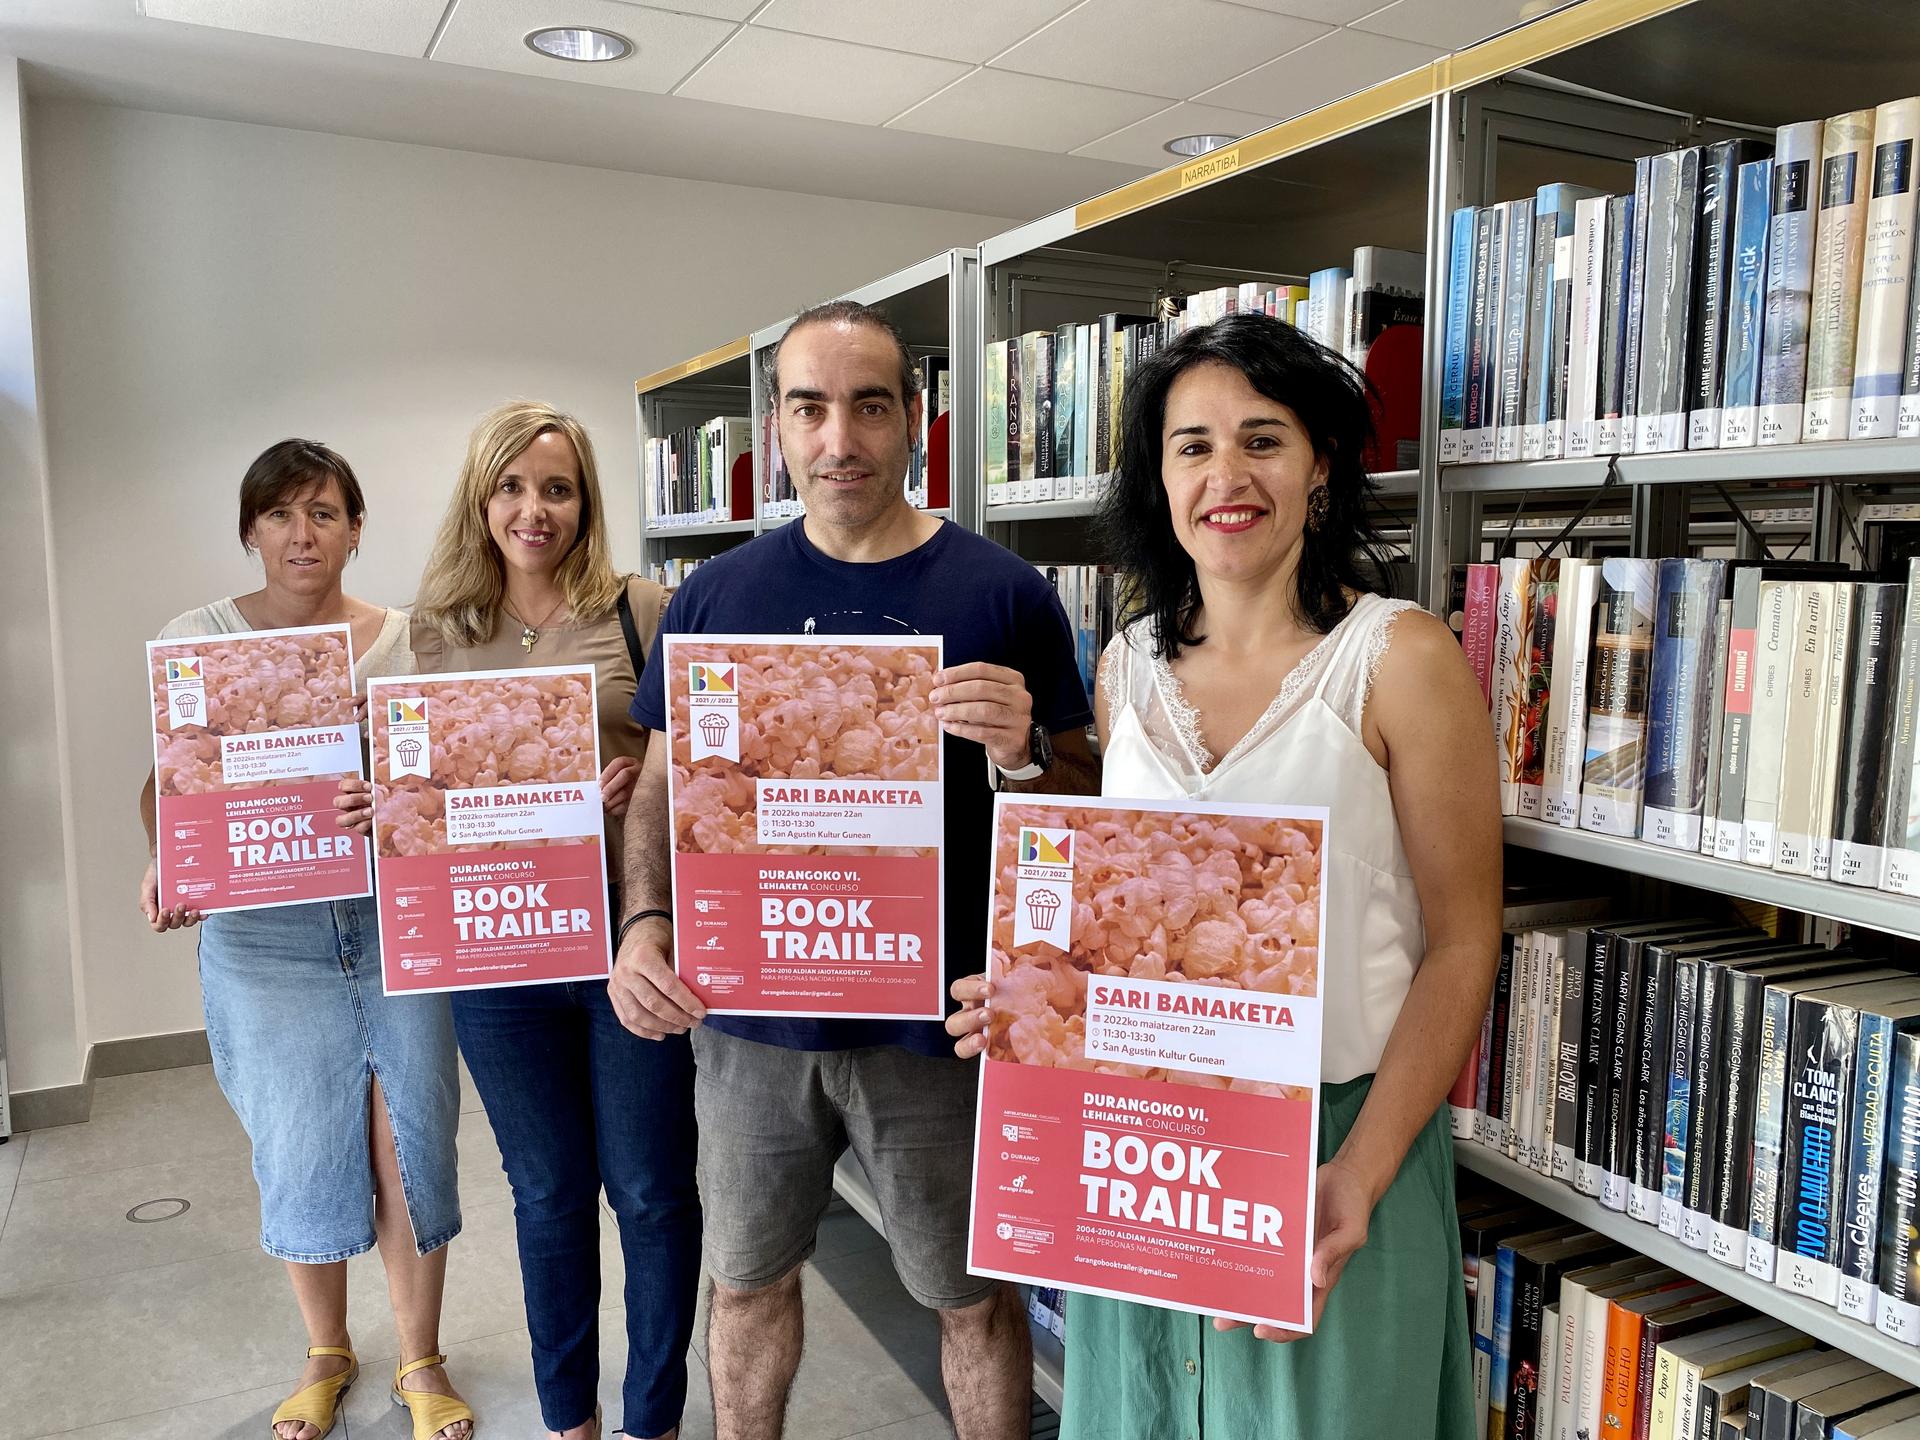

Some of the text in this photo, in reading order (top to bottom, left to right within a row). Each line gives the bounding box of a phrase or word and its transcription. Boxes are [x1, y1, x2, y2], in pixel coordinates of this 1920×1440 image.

[1184, 154, 1236, 184] NARRATIBA
[1480, 224, 1488, 240] EL
[1586, 218, 1596, 286] CATHERINE CHANTER
[1476, 242, 1488, 298] INFORME
[1742, 300, 1750, 328] Chacón
[1701, 319, 1714, 397] CARME CHAPARRO
[1498, 592, 1513, 676] Tracy Chevalier
[1767, 586, 1783, 698] CHIRBES Crematorio
[1870, 611, 1882, 646] LEE CHILD
[1804, 592, 1820, 698] CHIRBES En la orilla
[1600, 647, 1610, 712] MARCOS CHICOT
[1616, 648, 1630, 713] SÓCRATES
[1734, 650, 1748, 692] CHIROVICI
[1866, 657, 1878, 685] Personal
[1831, 674, 1840, 706] CHIRBES
[226, 731, 343, 752] SARI BANAKETA
[225, 795, 303, 809] DURANGOKO VI.
[226, 804, 302, 817] LEHIAKETA CONCURSO
[451, 789, 583, 809] SARI BANAKETA
[763, 788, 922, 804] SARI BANAKETA
[228, 813, 314, 844] BOOK
[459, 821, 494, 829] 11:30-13:30
[484, 811, 517, 819] maiatzaren
[472, 830, 496, 838] Agustin
[788, 830, 816, 838] Agustin
[228, 833, 353, 869] TRAILER
[449, 860, 535, 874] DURANGOKO VI.
[450, 870, 534, 883] LEHIAKETA CONCURSO
[759, 870, 860, 880] DURANGOKO VI.
[453, 882, 548, 914] BOOK
[759, 882, 808, 890] LEHIAKETA
[453, 906, 592, 943] TRAILER
[761, 898, 873, 927] BOOK
[760, 931, 922, 962] TRAILER
[1566, 966, 1575, 1000] PAMELA
[1573, 970, 1583, 998] CLARE
[1094, 986, 1294, 1026] SARI BANAKETA
[1589, 943, 1606, 1065] MARY HIGGINS CLARK
[1103, 1015, 1215, 1036] 2022ko maiatzaren 22an
[1103, 1029, 1155, 1043] 11:30-13:30
[1613, 970, 1629, 1080] MARY HIGGINS CLARK
[1641, 975, 1656, 1082] MARY HIGGINS CLARK
[1102, 1042, 1224, 1066] San Agustin Kultur Gunean
[1561, 1042, 1578, 1063] PIEL
[1558, 1070, 1577, 1102] BAJO
[1794, 1082, 1844, 1104] CLANCY
[1806, 1068, 1835, 1088] TOM
[1862, 1032, 1884, 1146] VERDAD OCULTA
[1082, 1109, 1205, 1135] LEHIAKETA CONCURSO
[1083, 1092, 1184, 1118] DURANGOKO
[1187, 1107, 1208, 1122] VI.
[1800, 1110, 1836, 1126] Blackwood
[1802, 1103, 1835, 1116] con Grant
[1082, 1130, 1222, 1188] BOOK
[1800, 1125, 1832, 1199] MUERTO
[1752, 1168, 1767, 1224] EL MAR
[1897, 1167, 1918, 1208] TODA
[1078, 1174, 1285, 1247] TRAILER
[1798, 1202, 1827, 1220] O
[1847, 1174, 1872, 1272] Ann Cleeves
[1076, 1224, 1215, 1255] 2004-2010 ALDIAN JAIOTAKOENTZAT
[1074, 1254, 1177, 1280] durangobooktrailer@gmail.com
[1075, 1234, 1274, 1277] PARA PERSONAS NACIDAS ENTRE LOS AÑOS 2004-2010
[1795, 1264, 1801, 1272] N
[1794, 1272, 1813, 1284] CLA
[1561, 1315, 1575, 1404] PAULO COELHO
[1605, 1346, 1616, 1394] PAULO
[1617, 1348, 1631, 1408] COELHO
[1658, 1357, 1670, 1400] Expo 58
[1682, 1369, 1694, 1435] antes de caer
